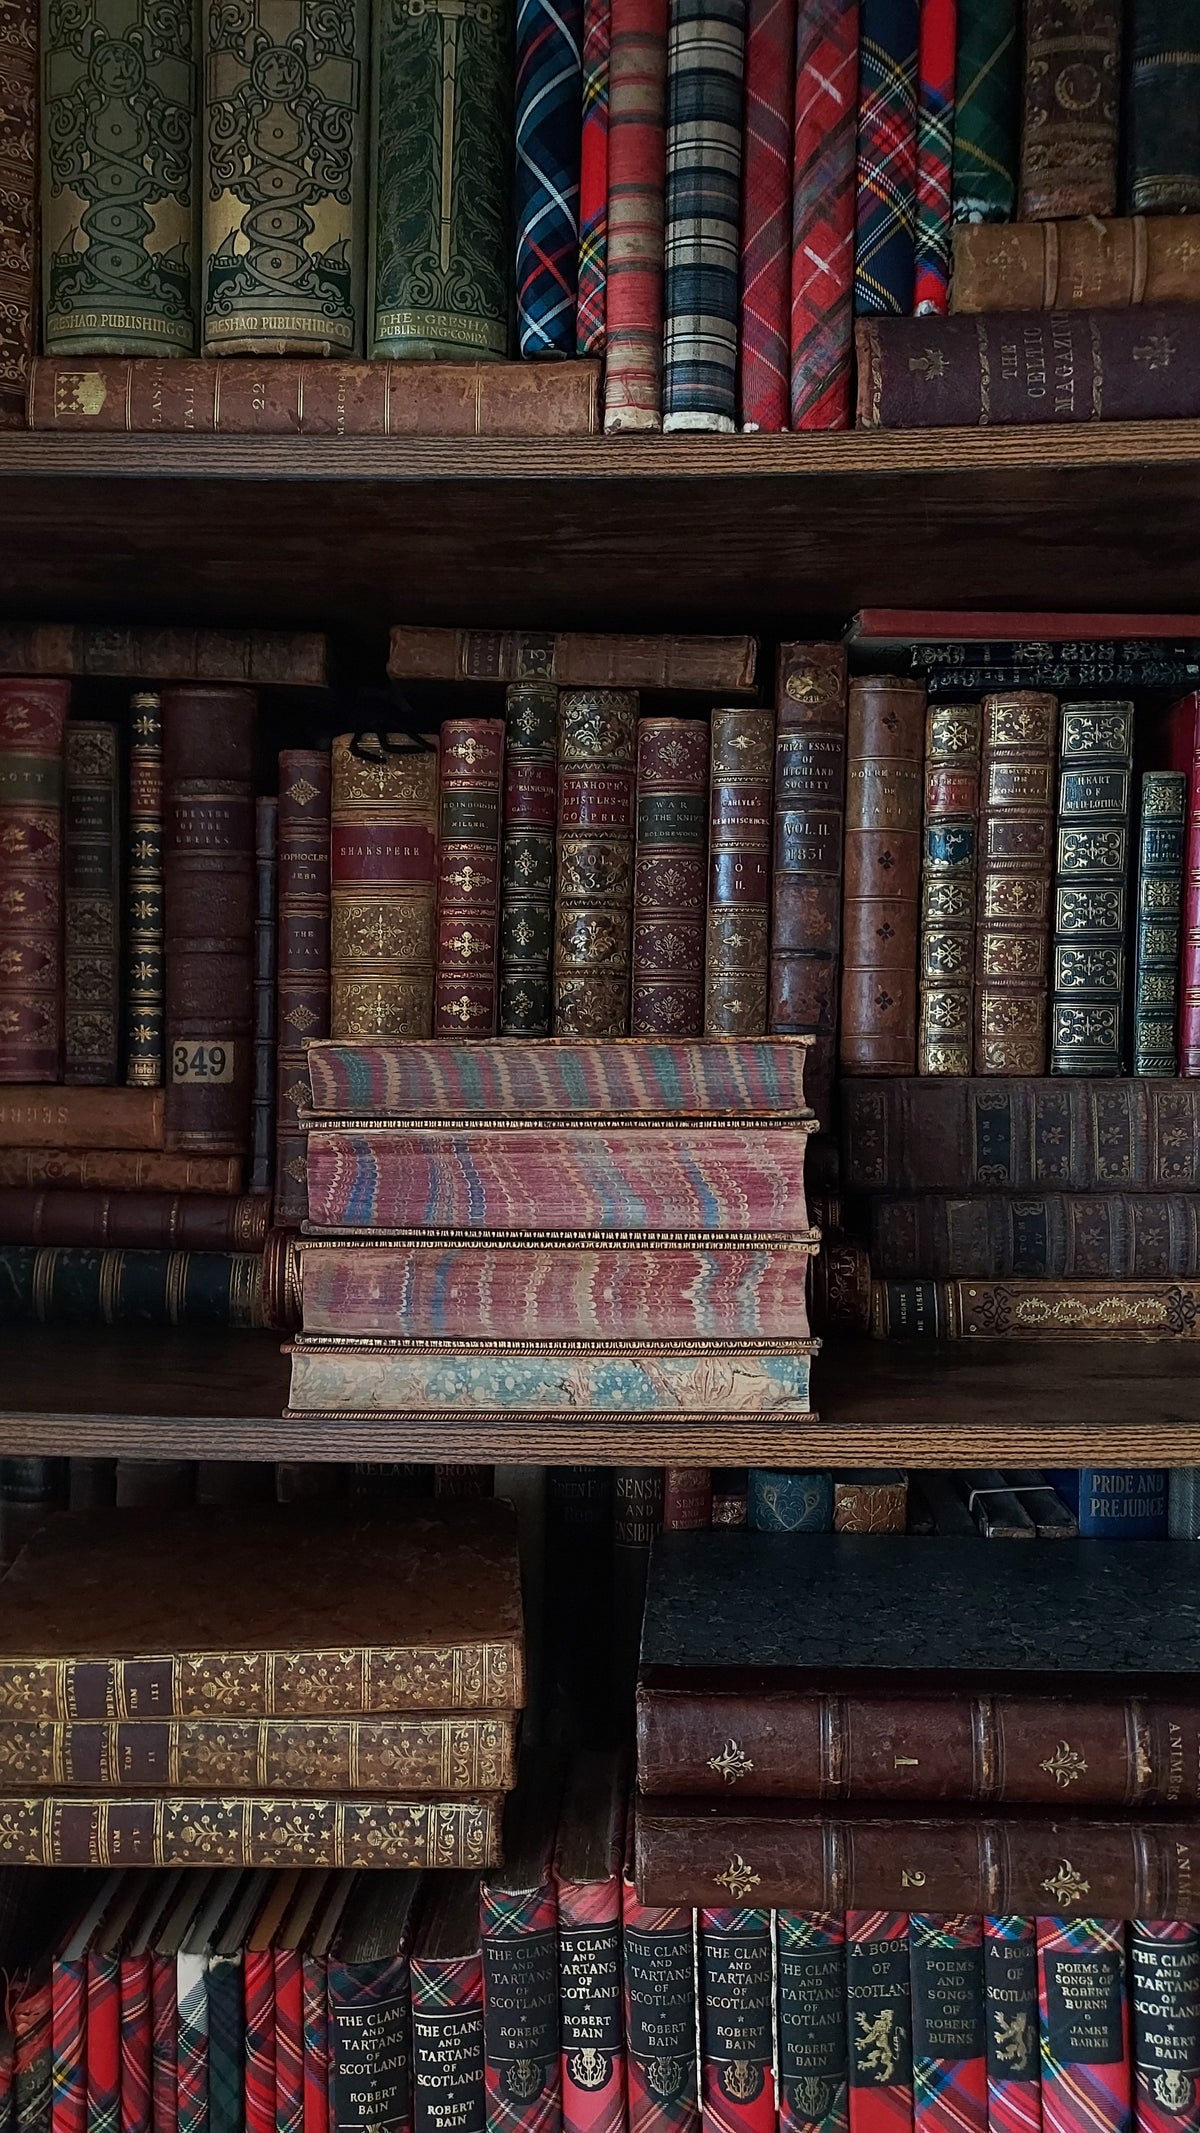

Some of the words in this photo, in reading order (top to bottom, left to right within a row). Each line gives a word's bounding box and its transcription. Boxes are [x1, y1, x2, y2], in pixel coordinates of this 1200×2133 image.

[100, 313, 175, 335] PUBLISHING
[260, 316, 333, 335] PUBLISHING
[334, 322, 351, 339] CO
[380, 312, 413, 326] THE
[424, 314, 490, 334] GRESHA
[1001, 343, 1019, 381] THE
[1023, 327, 1047, 399] CELTIC
[252, 382, 266, 411] 22
[808, 742, 842, 752] ESSAYS
[802, 755, 814, 764] OF
[782, 767, 834, 777] HIGHLAND
[1078, 775, 1111, 786] HEART
[1085, 787, 1102, 797] OF
[655, 801, 688, 810] WAR
[654, 813, 672, 822] THE
[293, 930, 315, 938] THE
[174, 1046, 226, 1077] 349
[982, 1120, 992, 1156] TOM
[1018, 1221, 1027, 1254] TOM
[616, 1477, 662, 1501] SENSE
[1091, 1474, 1134, 1494] PRIDE
[1137, 1474, 1164, 1494] AND
[625, 1504, 655, 1517] AND
[1089, 1497, 1164, 1518] PREJUDICE
[129, 1687, 139, 1710] TOM
[124, 1746, 133, 1771] TOM
[112, 1829, 121, 1854] TOM
[901, 1869, 925, 1889] 2
[576, 1936, 618, 1952] CLANS
[627, 1940, 652, 1957] THE
[653, 1941, 693, 1957] CLANS
[850, 1943, 866, 1957] A
[868, 1940, 909, 1956] BOOK
[487, 1947, 513, 1961] THE
[572, 1953, 596, 1962] AND
[704, 1945, 731, 1959] THE
[989, 1945, 1001, 1958] A
[1131, 1948, 1158, 1967] THE
[511, 1961, 534, 1972] AND
[649, 1959, 673, 1968] AND
[727, 1961, 752, 1971] AND
[871, 1961, 892, 1975] OF
[925, 1960, 975, 1973] POEMS
[1055, 1962, 1099, 1974] POEMS
[491, 1968, 553, 1985] TARTANS
[630, 1966, 692, 1982] TARTANS
[707, 1970, 770, 1985] TARTANS
[1006, 1967, 1025, 1981] OF
[1155, 1968, 1182, 1979] AND
[578, 1976, 593, 1986] OF
[799, 1978, 823, 1988] AND
[936, 1975, 965, 1987] AND
[1055, 1974, 1093, 1987] SONGS
[1098, 1974, 1114, 1986] OF
[1133, 1974, 1200, 1994] TARTANS
[515, 1986, 529, 1996] OF
[654, 1983, 669, 1993] OF
[732, 1986, 748, 1996] OF
[780, 1986, 842, 2001] TARTANS
[986, 1985, 1037, 2003] SCOTLAN
[1061, 1986, 1111, 1998] ROBERT
[489, 1992, 555, 2009] SCOTLAND
[927, 1989, 974, 2001] SONGS
[1160, 1994, 1178, 2005] OF
[803, 2003, 819, 2013] OF
[942, 2004, 961, 2016] OF
[1064, 1998, 1108, 2010] BURNS
[336, 2015, 364, 2027] THE
[366, 2005, 407, 2026] CLANS
[563, 2015, 612, 2026] ROBERT
[414, 2022, 440, 2038] THE
[442, 2019, 484, 2037] CLANS
[500, 2024, 547, 2037] ROBERT
[641, 2020, 687, 2035] ROBERT
[925, 2018, 977, 2030] ROBERT
[1069, 2025, 1109, 2035] JAMES
[361, 2026, 385, 2037] AND
[572, 2027, 604, 2039] BAIN
[716, 2025, 765, 2038] ROBERT
[928, 2032, 974, 2044] BURNS
[341, 2030, 404, 2051] TARTANS
[437, 2038, 462, 2049] AND
[508, 2038, 539, 2049] BAIN
[648, 2035, 679, 2048] BAIN
[725, 2039, 756, 2050] BAIN
[1144, 2031, 1197, 2048] ROBERT
[418, 2044, 481, 2063] TARTANS
[787, 2042, 836, 2055] ROBERT
[1154, 2046, 1189, 2061] BAIN
[366, 2051, 381, 2062] OF
[795, 2056, 828, 2067] BAIN
[339, 2054, 407, 2075] SCOTLAND
[442, 2063, 458, 2073] OF
[416, 2069, 485, 2088] SCOTLAND
[350, 2085, 398, 2103] ROBERT
[358, 2101, 390, 2116] BAIN
[426, 2099, 476, 2116] ROBERT
[434, 2114, 468, 2128] BAIN
